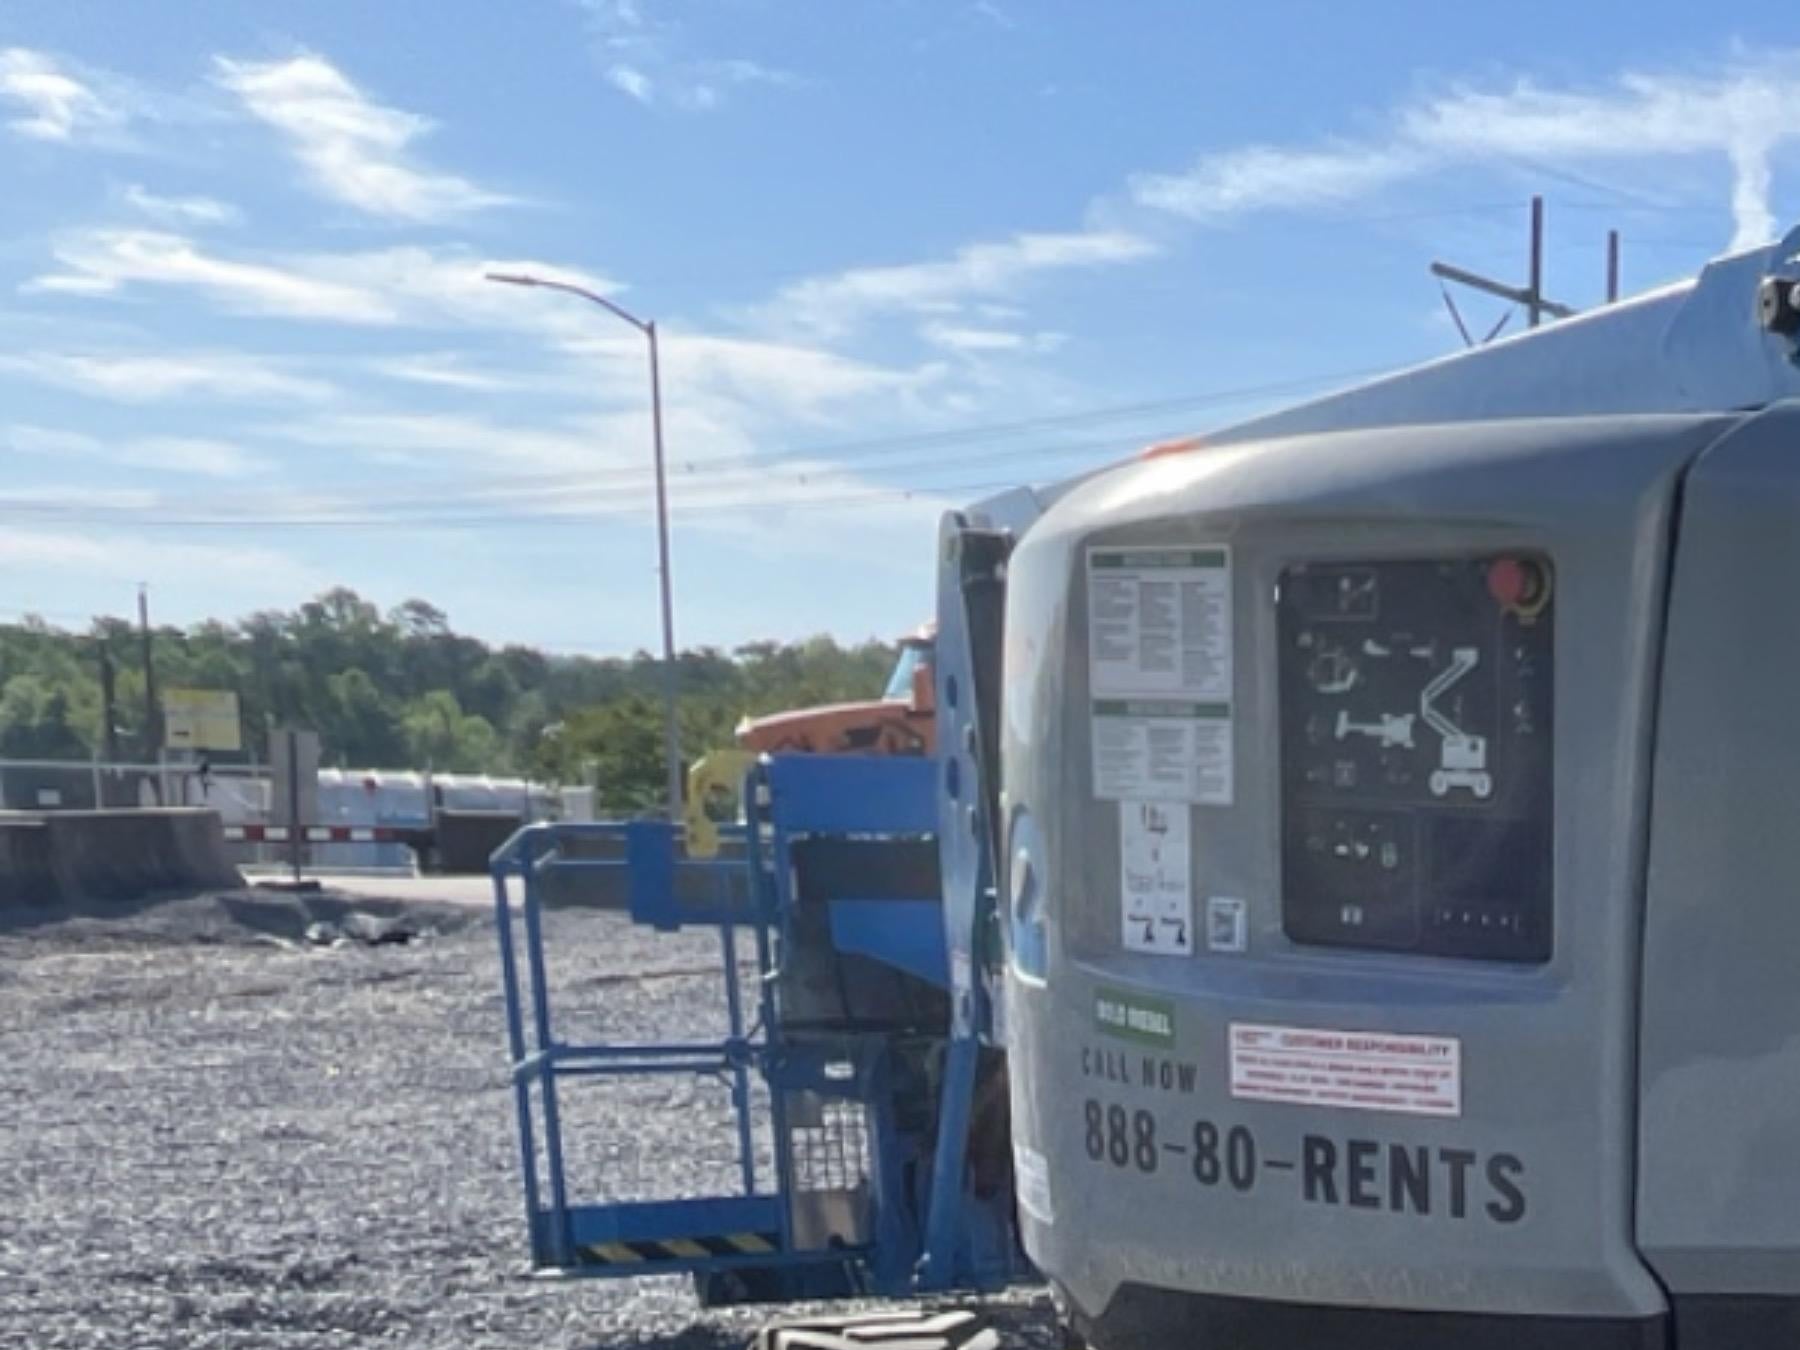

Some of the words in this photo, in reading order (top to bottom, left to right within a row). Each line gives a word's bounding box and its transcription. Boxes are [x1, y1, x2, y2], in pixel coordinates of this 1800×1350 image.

[1082, 1046, 1129, 1084] CALL
[1142, 1056, 1197, 1092] NOW
[1084, 1100, 1527, 1224] 888-80-RENTS
